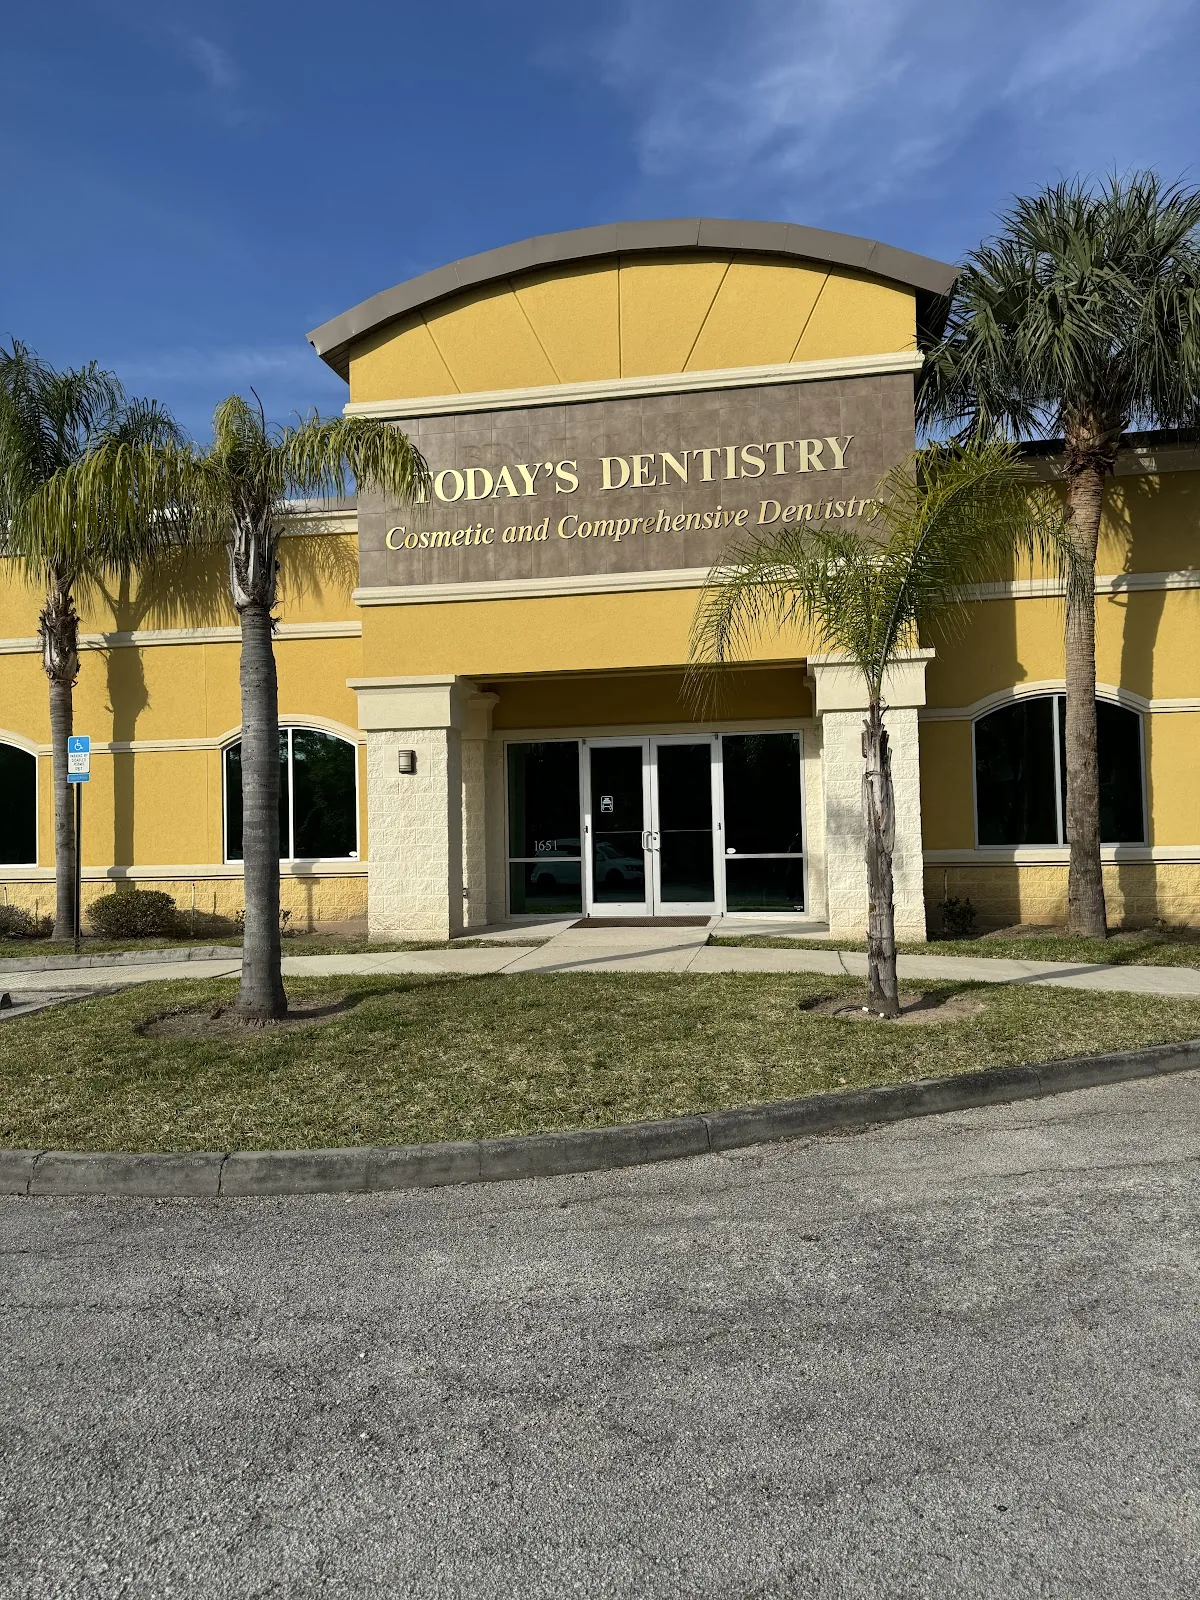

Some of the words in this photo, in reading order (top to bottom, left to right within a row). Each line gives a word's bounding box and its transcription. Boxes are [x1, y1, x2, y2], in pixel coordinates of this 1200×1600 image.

[413, 460, 580, 504] TODAY'S
[598, 435, 855, 491] DENTISTRY
[385, 522, 496, 551] Cosmetic
[501, 517, 550, 544] and
[556, 504, 749, 543] Comprehensive
[534, 840, 558, 851] 1651
